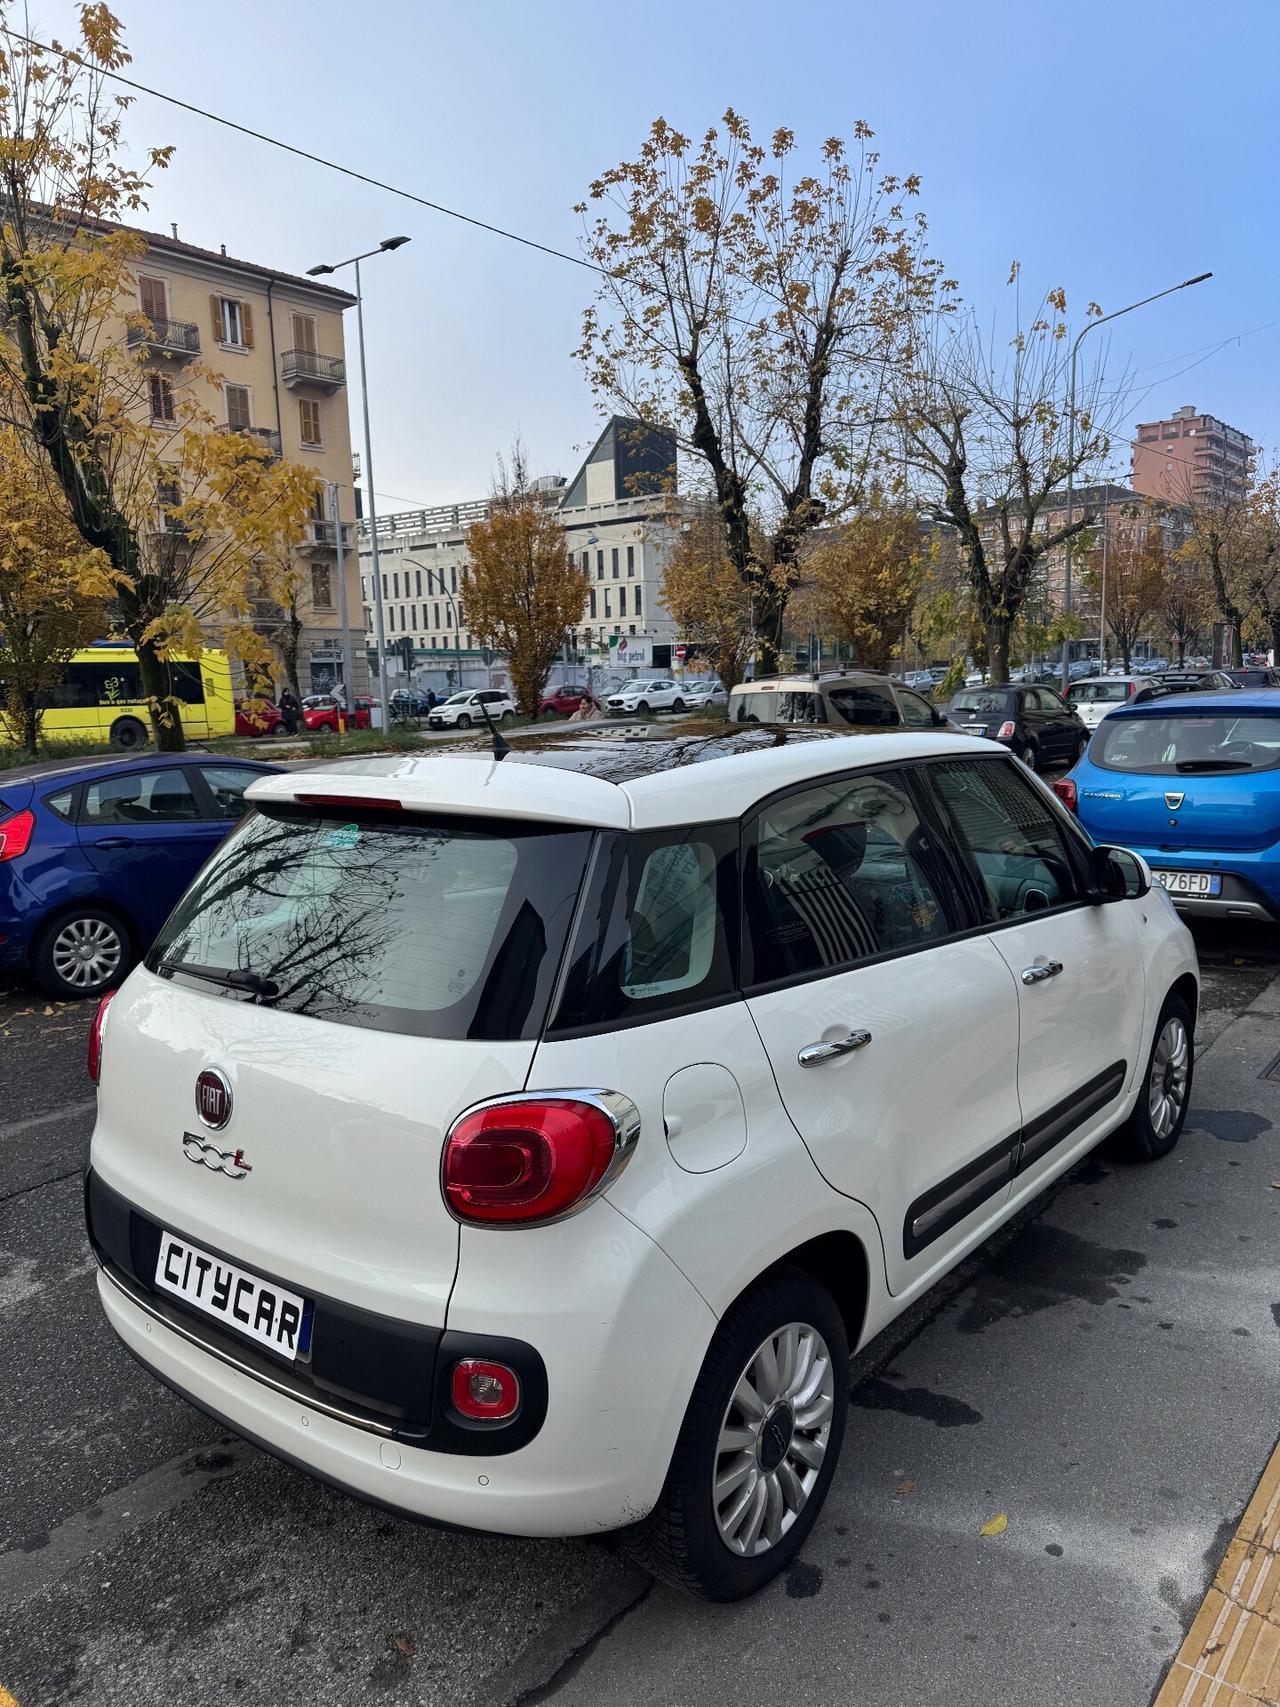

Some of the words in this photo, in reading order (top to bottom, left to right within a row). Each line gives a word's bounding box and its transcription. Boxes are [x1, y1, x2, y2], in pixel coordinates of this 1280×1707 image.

[629, 648, 645, 663] petrol
[1159, 872, 1209, 891] 876FD
[202, 1084, 222, 1115] FIAT
[182, 1131, 252, 1180] 500L
[164, 1242, 300, 1350] CITYCAR
